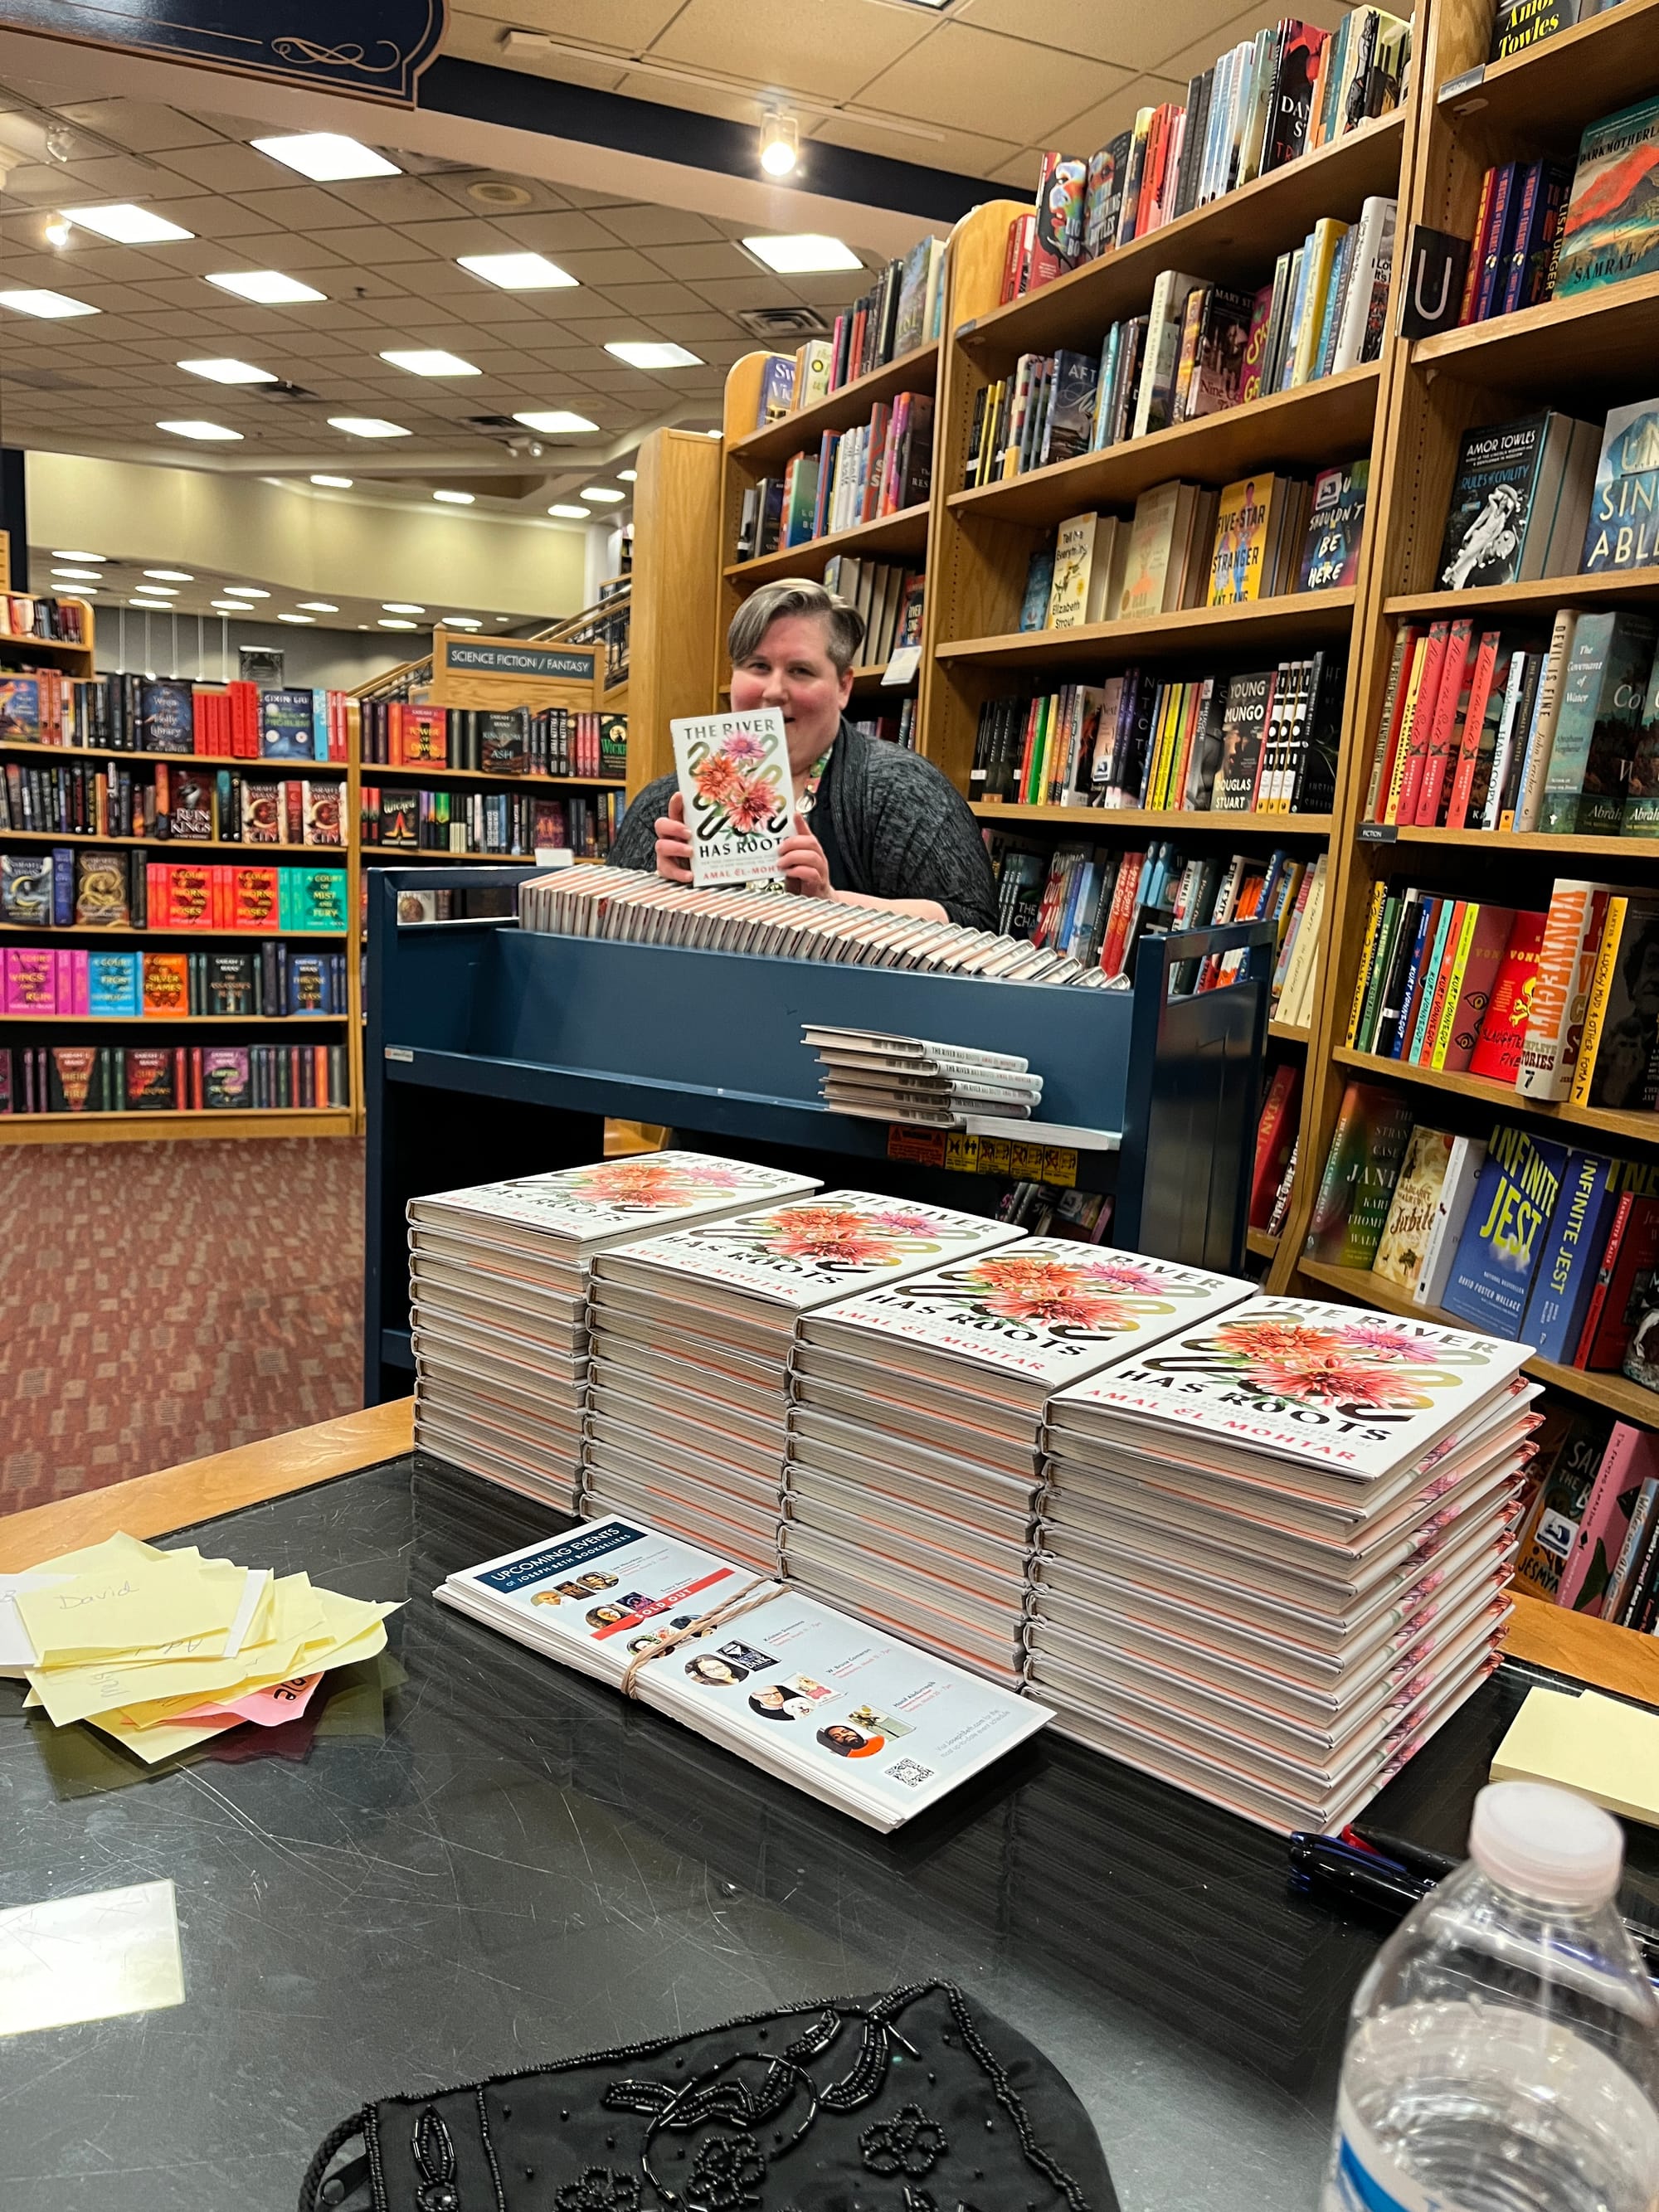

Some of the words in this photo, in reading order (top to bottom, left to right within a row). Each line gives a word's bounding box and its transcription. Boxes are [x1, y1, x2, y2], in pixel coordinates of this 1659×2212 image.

[1498, 13, 1559, 60] Towles
[1557, 203, 1569, 236] LISA
[1545, 238, 1562, 290] UNGER
[1414, 248, 1453, 321] U
[1467, 437, 1499, 457] AMOR
[1501, 430, 1536, 450] TOWLES
[1461, 472, 1487, 491] RULES
[1493, 464, 1530, 484] CIVILITY
[1216, 504, 1267, 533] FIVE-STAR
[1308, 502, 1365, 532] SHOULDN'T
[1318, 533, 1341, 558] BE
[1212, 546, 1259, 574] STRANGER
[1307, 562, 1344, 588] HERE
[1549, 625, 1566, 666] DEVIL
[1579, 644, 1594, 656] The
[450, 649, 494, 665] SCIENCE
[497, 653, 538, 669] FICTION
[546, 658, 591, 673] FANTASY
[1546, 668, 1558, 682] IS
[1567, 660, 1603, 673] Covenant
[264, 693, 291, 704] CIXIN
[294, 694, 309, 705] LIU
[1229, 679, 1267, 699] YOUNG
[1540, 688, 1555, 717] FINE
[1565, 693, 1589, 703] Water
[1224, 703, 1265, 724] MUNGO
[684, 723, 718, 740] THE
[722, 718, 775, 737] RIVER
[1374, 716, 1390, 764] MANDATORY
[490, 750, 513, 760] ASH
[1495, 730, 1506, 768] HARD
[1215, 777, 1253, 791] DOUGLAS
[1486, 768, 1499, 806] COPY
[176, 807, 211, 820] RUIN
[1214, 796, 1245, 809] STUART
[170, 820, 212, 834] KINGS
[249, 834, 277, 843] CITY
[310, 834, 339, 843] CITY
[1362, 829, 1383, 839] FICTION
[698, 842, 731, 858] HAS
[314, 874, 343, 882] COURT
[702, 870, 732, 881] AMAL
[1180, 868, 1193, 907] ANIMAL
[313, 891, 337, 899] MIST
[313, 908, 338, 917] FURY
[1378, 923, 1389, 958] CANDIDE
[148, 975, 179, 983] SILVER
[1408, 964, 1417, 990] KURT
[1528, 890, 1588, 1040] VONNEGUT
[1598, 954, 1611, 987] LUCKY
[1438, 974, 1447, 999] KURT
[1451, 975, 1461, 999] KURT
[1593, 989, 1603, 1009] MUD
[1398, 991, 1412, 1038] VONNEGUT
[1415, 998, 1429, 1043] VONNEGUT
[1426, 1001, 1441, 1048] VONNEGUT
[1439, 1000, 1453, 1048] VONNEGUT
[1582, 1020, 1597, 1052] OTHER
[932, 1046, 941, 1057] THE
[942, 1048, 956, 1058] RIVER
[946, 1064, 955, 1073] THE
[956, 1066, 971, 1076] RIVER
[1524, 1070, 1535, 1089] 7
[1577, 1057, 1589, 1083] FOMA
[969, 1084, 983, 1092] RIVER
[1574, 1086, 1584, 1101] 7
[656, 1152, 700, 1164] THE
[707, 1160, 797, 1184] RIVER
[1488, 1124, 1559, 1218] INFINITE
[438, 1194, 483, 1208] AMAL
[471, 1184, 525, 1200] HAS
[528, 1196, 632, 1224] ROOTS
[835, 1193, 887, 1208] THE
[902, 1205, 998, 1234] RIVER
[1562, 1158, 1598, 1246] INFINITE
[1479, 1175, 1543, 1261] JEST
[625, 1247, 676, 1262] AMAL
[681, 1260, 799, 1296] EL-MOHTAR
[660, 1236, 721, 1252] HAS
[727, 1252, 844, 1286] ROOTS
[1033, 1239, 1099, 1259] THE
[1108, 1253, 1228, 1291] RIVER
[1550, 1247, 1574, 1296] JEST
[1457, 1275, 1474, 1291] DAVID
[1474, 1282, 1496, 1300] FOSTER
[1495, 1290, 1522, 1312] WALLACE
[833, 1308, 893, 1328] AMAL
[899, 1324, 1047, 1371] EL-MOHTAR
[865, 1294, 946, 1316] HAS
[946, 1312, 1088, 1358] ROOTS
[1264, 1299, 1343, 1320] THE
[1359, 1313, 1501, 1356] RIVER
[1115, 1369, 1214, 1395] HAS
[1218, 1392, 1394, 1442] ROOTS
[1084, 1388, 1160, 1412] AMAL
[1172, 1407, 1359, 1463] EL-MOHTAR
[489, 1546, 572, 1582] UPCOMING
[569, 1527, 620, 1552] EVENTS
[517, 1556, 576, 1583] JOSEPH-BETH
[575, 1534, 631, 1559] BOOKSELLERS
[59, 1580, 139, 1611] David
[635, 1598, 669, 1620] SOLD
[667, 1587, 693, 1604] OUT
[746, 1655, 772, 1670] DARK
